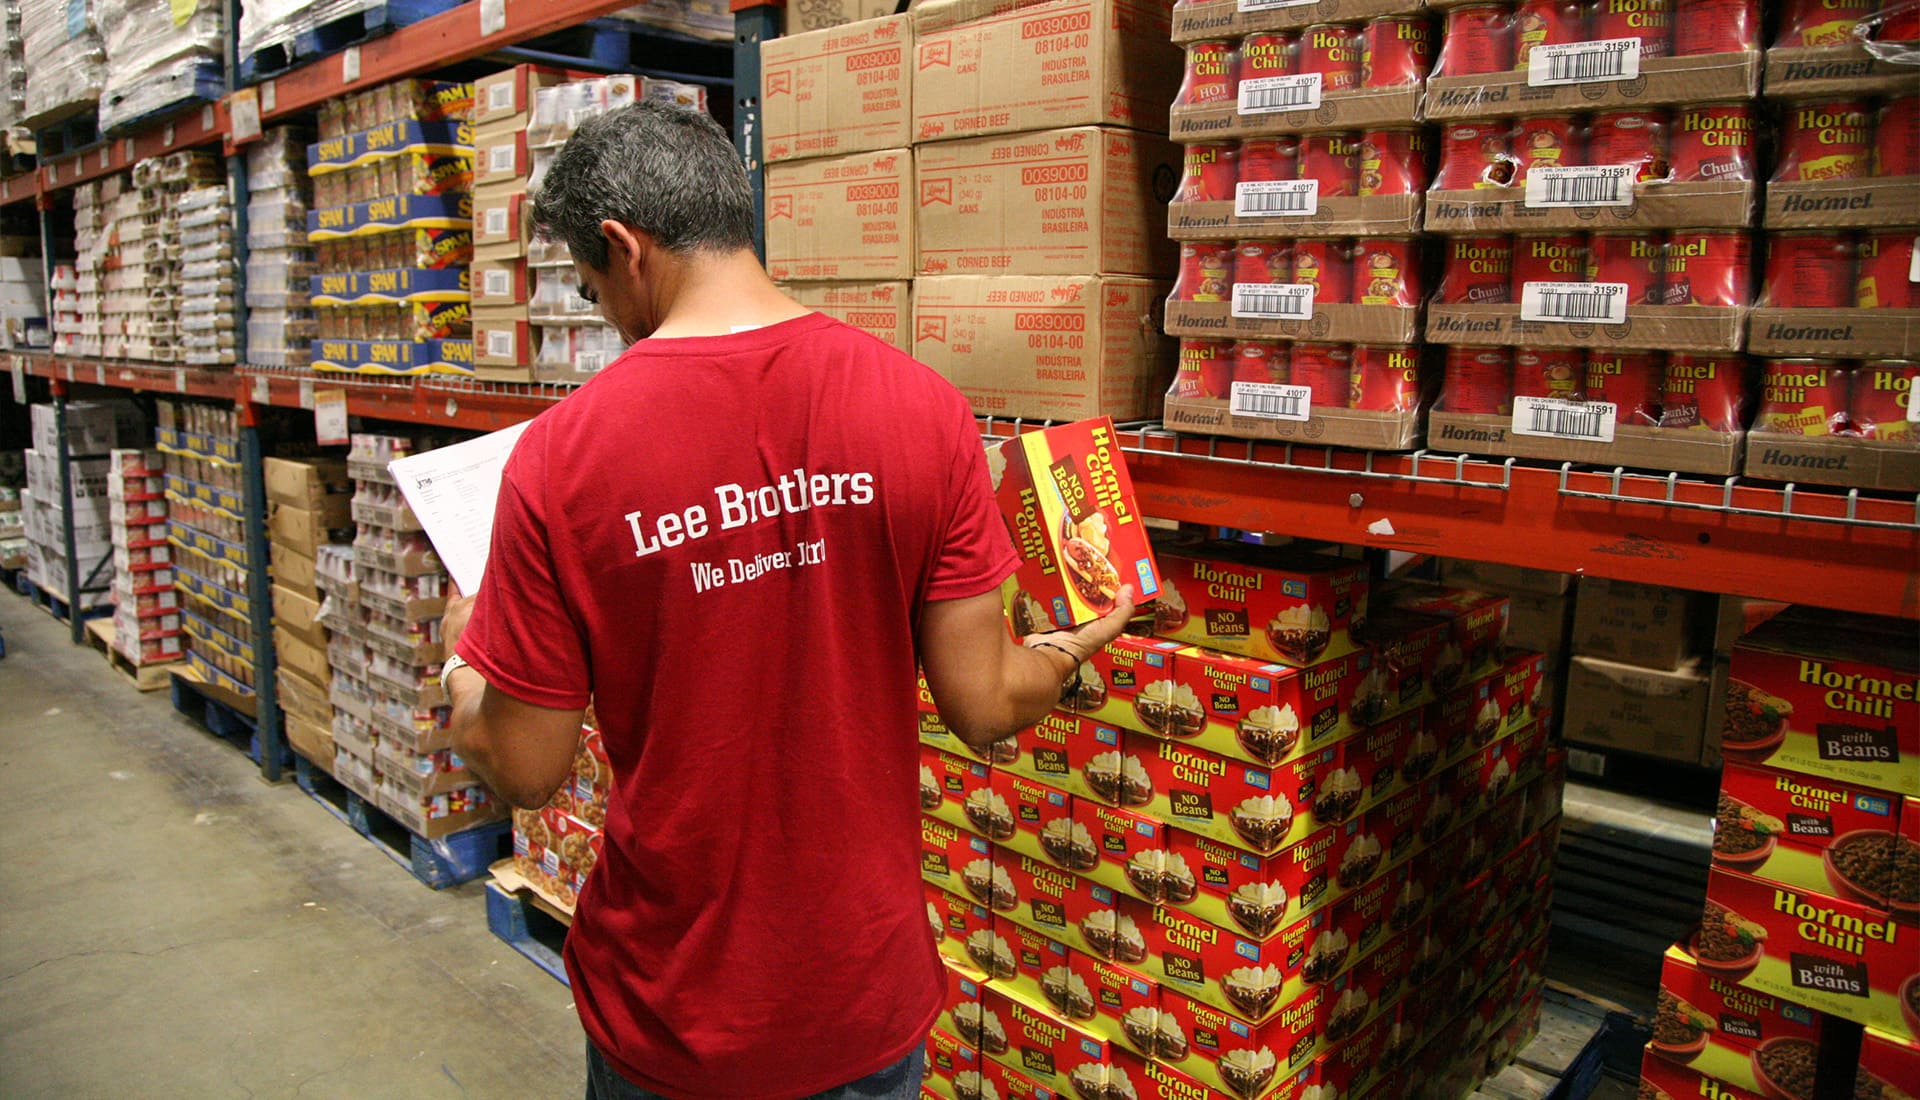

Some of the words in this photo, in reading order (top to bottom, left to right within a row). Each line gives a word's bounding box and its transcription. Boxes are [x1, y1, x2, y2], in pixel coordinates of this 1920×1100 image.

[1024, 14, 1088, 38] 0039000
[1035, 33, 1088, 54] 08104-00
[1605, 40, 1637, 51] 31591
[848, 50, 899, 70] 0039000
[957, 63, 977, 74] CANS
[857, 69, 900, 86] 08104-00
[1041, 70, 1090, 86] BRASILEIRA
[1784, 60, 1875, 81] Hormel
[1296, 77, 1317, 86] 41017
[1199, 84, 1227, 98] HOT
[954, 115, 987, 131] CORNED
[990, 113, 1010, 128] BEEF
[1181, 116, 1232, 133] Hormel
[367, 124, 394, 151] SPAM
[1702, 131, 1748, 147] Chili
[319, 139, 344, 161] SPAM
[1024, 165, 1087, 185] 0039000
[1600, 167, 1631, 178] 31591
[1803, 164, 1834, 180] Less
[848, 184, 899, 201] 0039000
[1035, 186, 1087, 202] 08104-00
[1292, 183, 1314, 192] 41017
[368, 197, 396, 221] SPAM
[857, 202, 898, 217] 08104-00
[959, 204, 979, 215] CANS
[1784, 192, 1873, 212] Hormel
[318, 206, 344, 228] SPAM
[1042, 217, 1089, 234] BRASILEIRA
[435, 231, 470, 255] SPAM
[957, 257, 990, 269] CORNED
[993, 256, 1012, 268] BEEF
[321, 275, 347, 295] SPAM
[369, 271, 396, 293] SPAM
[1593, 285, 1624, 295] 31591
[987, 290, 1006, 302] BEEF
[1010, 291, 1045, 302] CORNED
[1288, 287, 1310, 296] 41017
[432, 304, 469, 328] SPAM
[848, 313, 896, 328] 0039000
[1017, 314, 1083, 330] 0039000
[1177, 314, 1228, 329] Hormel
[1766, 323, 1854, 341] Hormel
[952, 344, 972, 353] CANS
[1028, 334, 1083, 349] 08104-00
[323, 342, 347, 362] SPAM
[370, 342, 398, 364] SPAM
[1036, 369, 1086, 381] BRASILEIRA
[1286, 389, 1307, 397] 41017
[1764, 387, 1805, 404] Chili
[987, 397, 1007, 408] BEEF
[1173, 410, 1225, 426] Hormel
[1773, 413, 1823, 432] Sodium
[1441, 424, 1506, 443] Hormel
[1762, 449, 1850, 470] Hormel
[1086, 452, 1112, 508] Chili
[1091, 426, 1133, 525] Hormel
[1053, 465, 1082, 517] Beans
[1068, 474, 1085, 500] NO
[625, 504, 709, 556] Lee
[1015, 512, 1037, 559] Chili
[1020, 487, 1056, 576] Hormel
[691, 562, 725, 593] We
[728, 550, 792, 584] Deliver
[1138, 562, 1147, 576] 6
[1193, 562, 1263, 590] Hormel
[1207, 583, 1246, 603] Chili
[1217, 612, 1235, 623] NO
[1210, 621, 1245, 634] Beans
[1105, 643, 1142, 662] Hormel
[1112, 654, 1134, 668] Chili
[1113, 677, 1133, 685] Beans
[1204, 665, 1247, 684] Hormel
[1304, 660, 1348, 691] Hormel
[1213, 678, 1237, 692] Chili
[1314, 683, 1338, 701] Chili
[1213, 702, 1236, 710] Beans
[1824, 691, 1894, 719] Chili
[926, 714, 939, 723] NO
[1319, 711, 1332, 721] NO
[922, 722, 946, 734] Beans
[1035, 725, 1066, 745] Chili
[1314, 717, 1336, 737] Beans
[1842, 732, 1873, 744] with
[1042, 751, 1057, 762] NO
[1827, 740, 1890, 758] Beans
[1037, 759, 1066, 772] Beans
[1159, 742, 1227, 777] Hormel
[1172, 764, 1209, 787] Chili
[1775, 776, 1848, 804] Hormel
[1181, 794, 1199, 805] NO
[1790, 795, 1830, 812] Chili
[1856, 797, 1870, 809] 6
[1174, 803, 1208, 816] Beans
[1097, 808, 1134, 829] Hormel
[1104, 821, 1125, 834] Chili
[1792, 822, 1830, 834] Beans
[921, 831, 947, 850] Chili
[1104, 842, 1124, 850] Beans
[1293, 831, 1336, 864] Hormel
[1195, 839, 1236, 860] Hormel
[928, 854, 941, 864] NO
[1204, 852, 1227, 866] Chili
[1303, 851, 1327, 873] Chili
[923, 862, 947, 874] Beans
[1021, 856, 1077, 891] Hormel
[1033, 876, 1063, 899] Chili
[1205, 875, 1226, 883] Beans
[1040, 903, 1055, 914] NO
[1773, 890, 1897, 944] Hormel
[1035, 912, 1063, 926] Beans
[1152, 905, 1218, 945] Hormel
[1166, 930, 1201, 953] Chili
[1797, 922, 1865, 955] Chili
[1174, 957, 1192, 969] NO
[1813, 963, 1844, 976] with
[1093, 963, 1129, 985] Hormel
[1168, 966, 1200, 981] Beans
[1799, 969, 1861, 993] Beans
[1101, 975, 1121, 990] Chili
[1709, 978, 1776, 1011] Hormel
[1187, 1001, 1227, 1026] Hormel
[1281, 993, 1324, 1028] Hormel
[1723, 996, 1759, 1017] Chili
[1783, 1005, 1794, 1018] 6
[1011, 1004, 1066, 1042] Hormel
[1195, 1016, 1217, 1031] Chili
[1291, 1013, 1315, 1034] Chili
[1724, 1022, 1757, 1037] Beans
[1023, 1025, 1053, 1048] Chili
[1195, 1036, 1217, 1046] Beans
[1200, 1030, 1211, 1039] NO
[1291, 1040, 1313, 1064] Beans
[1296, 1039, 1308, 1050] NO
[1030, 1051, 1044, 1062] NO
[1025, 1059, 1052, 1073] Beans
[1144, 1062, 1209, 1100] Hormel
